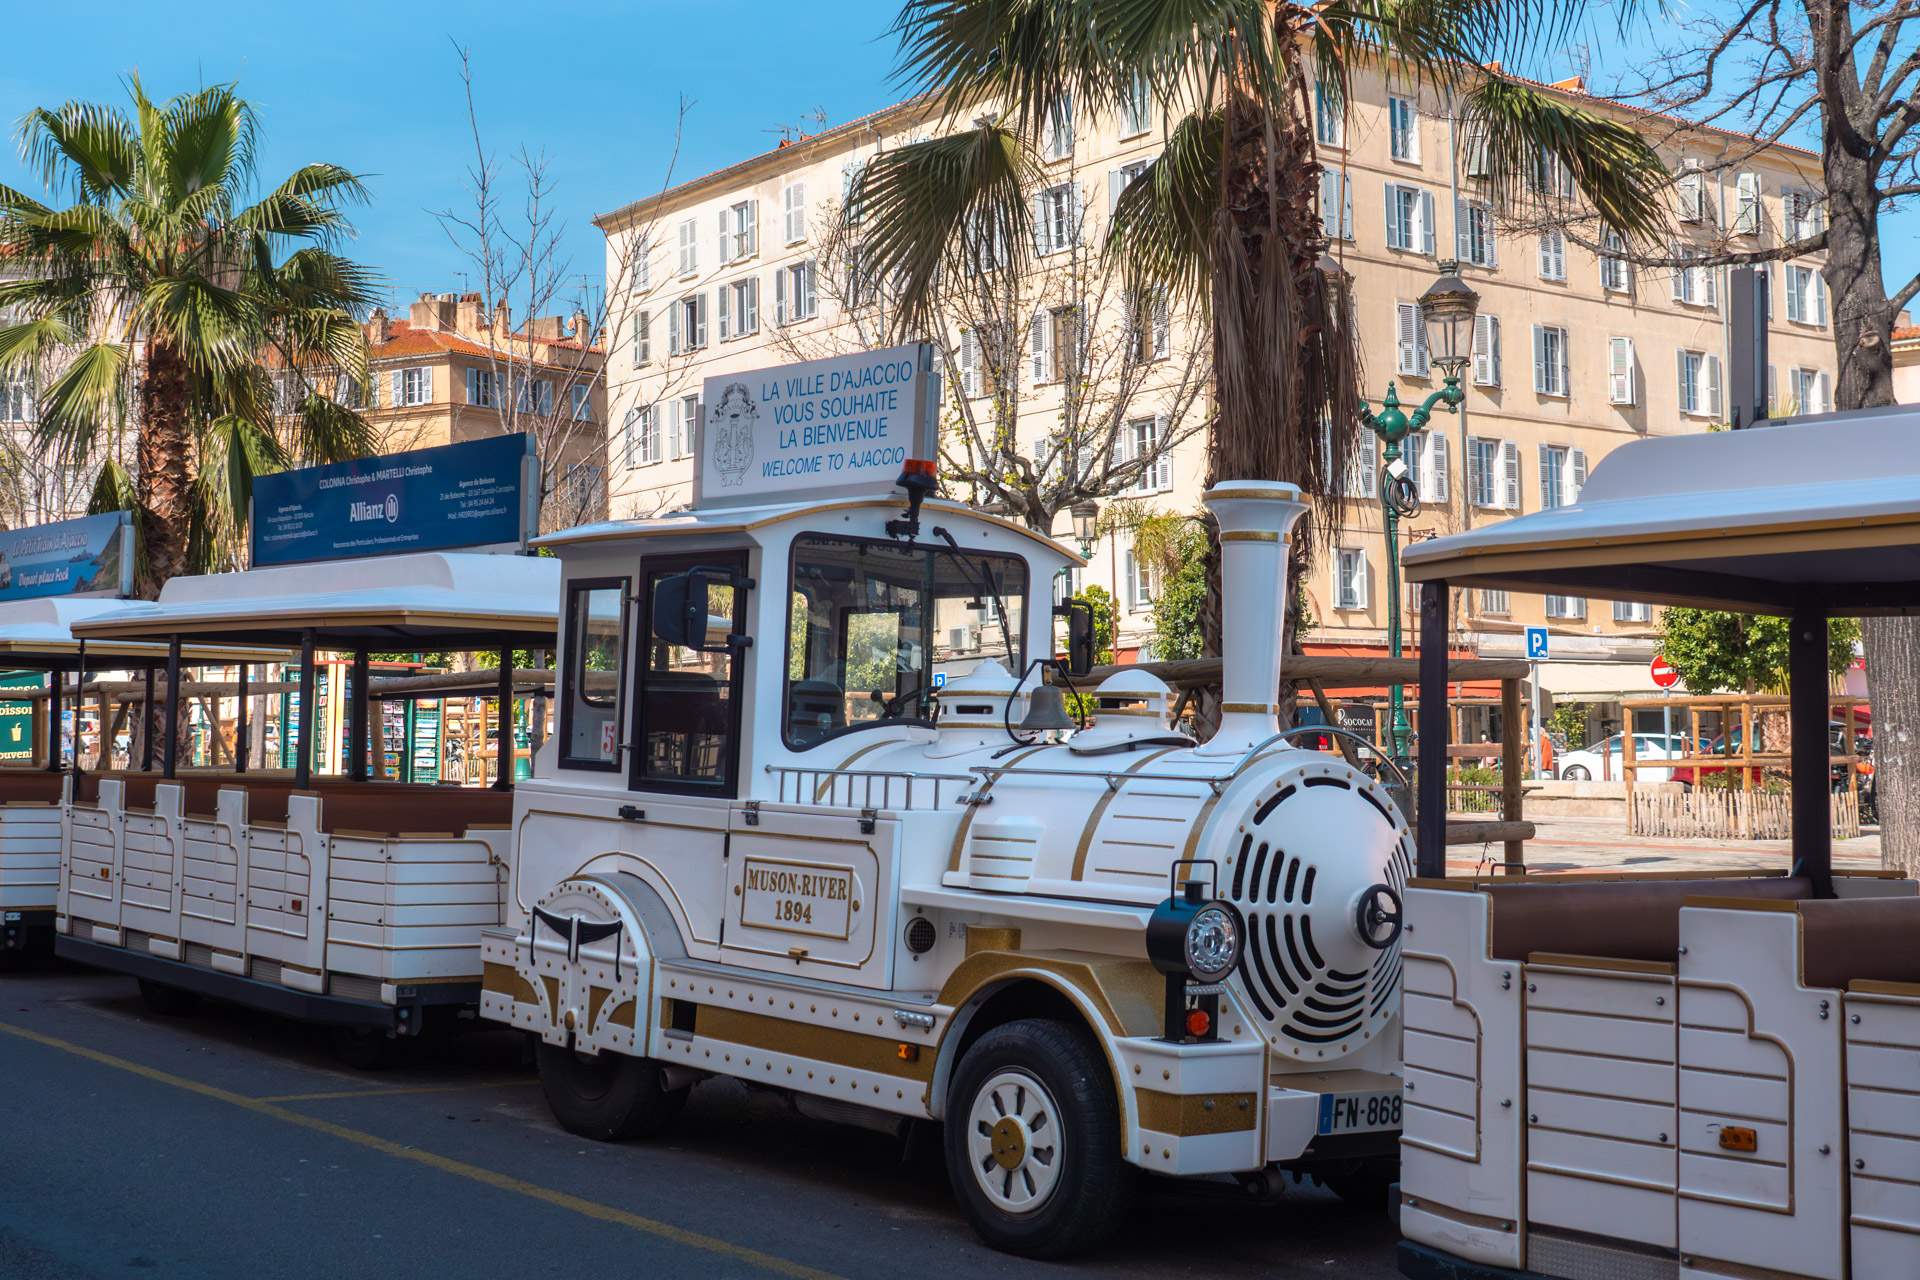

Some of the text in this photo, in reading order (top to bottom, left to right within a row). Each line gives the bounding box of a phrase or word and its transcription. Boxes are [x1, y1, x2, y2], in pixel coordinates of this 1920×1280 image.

[762, 360, 913, 401] LA VILLE D'AJACCIO
[774, 389, 898, 425] VOUS SOUHAITE
[779, 417, 888, 449] LA BIENVENUE
[319, 477, 346, 489] COLONNA
[376, 467, 405, 481] MARTELLI
[405, 464, 433, 477] Christophe
[762, 446, 905, 477] WELCOME TO AJACCIO
[349, 501, 384, 522] Allianz
[1532, 633, 1543, 653] P
[775, 899, 812, 924] 1894
[1334, 1094, 1402, 1129] FN-868
